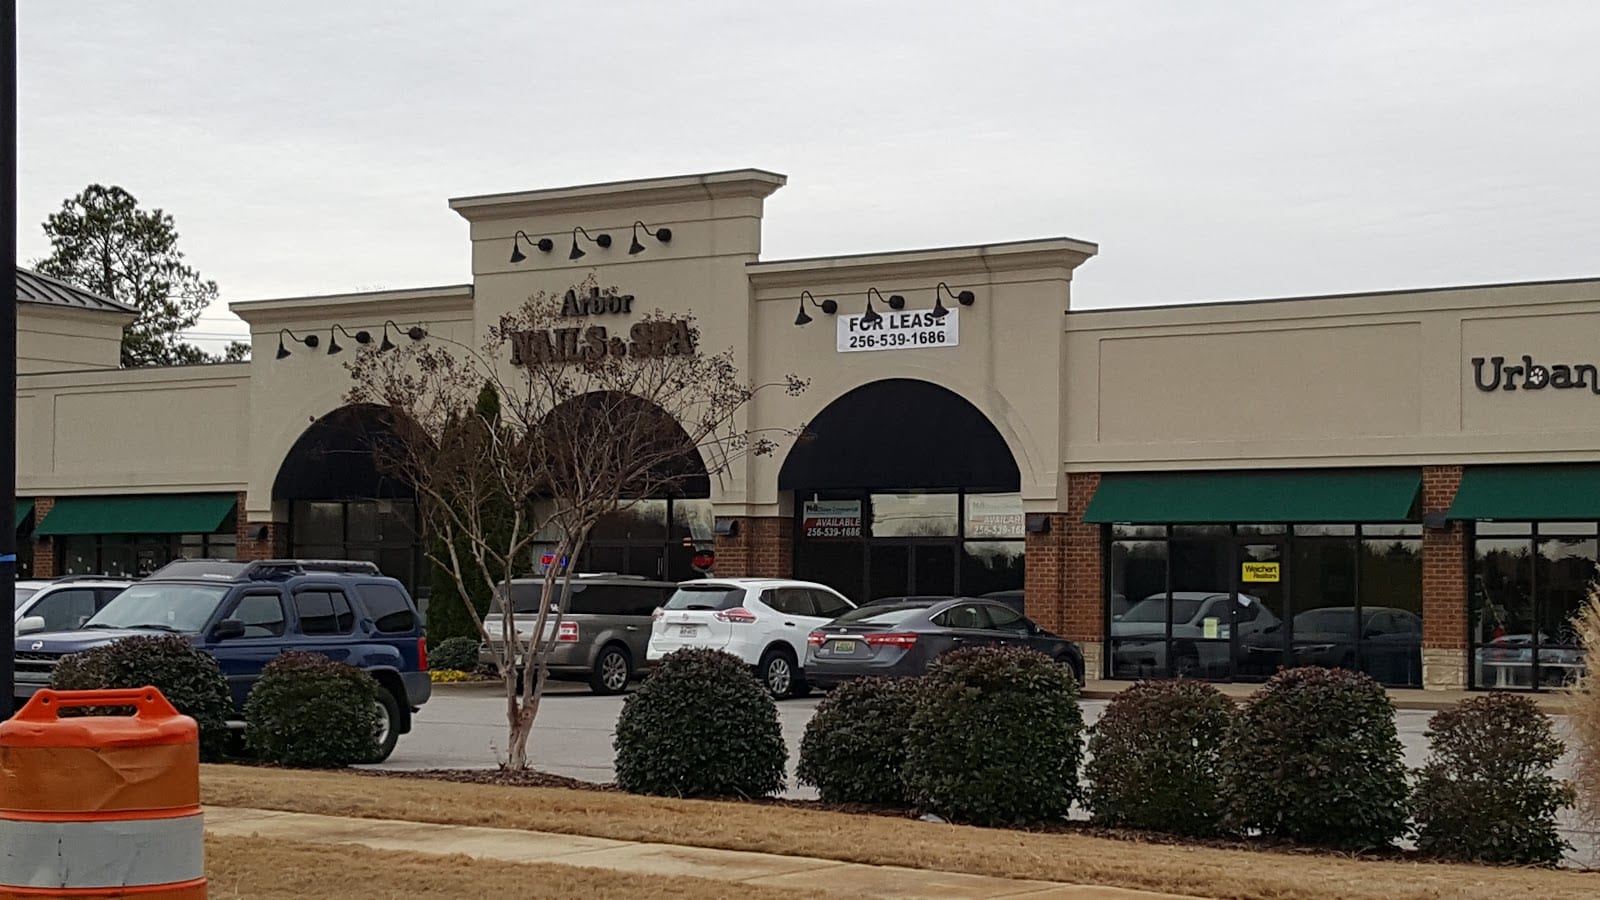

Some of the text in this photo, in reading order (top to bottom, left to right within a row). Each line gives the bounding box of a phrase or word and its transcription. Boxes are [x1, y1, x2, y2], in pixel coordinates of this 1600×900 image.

[560, 287, 634, 316] Arbor
[890, 312, 945, 329] LEASE
[510, 326, 607, 365] NAILS
[629, 320, 695, 358] SPA
[849, 331, 946, 348] 256-539-1686
[1471, 355, 1600, 395] Urban
[815, 517, 861, 527] AVAILABLE
[806, 527, 861, 537] 256-539-1686
